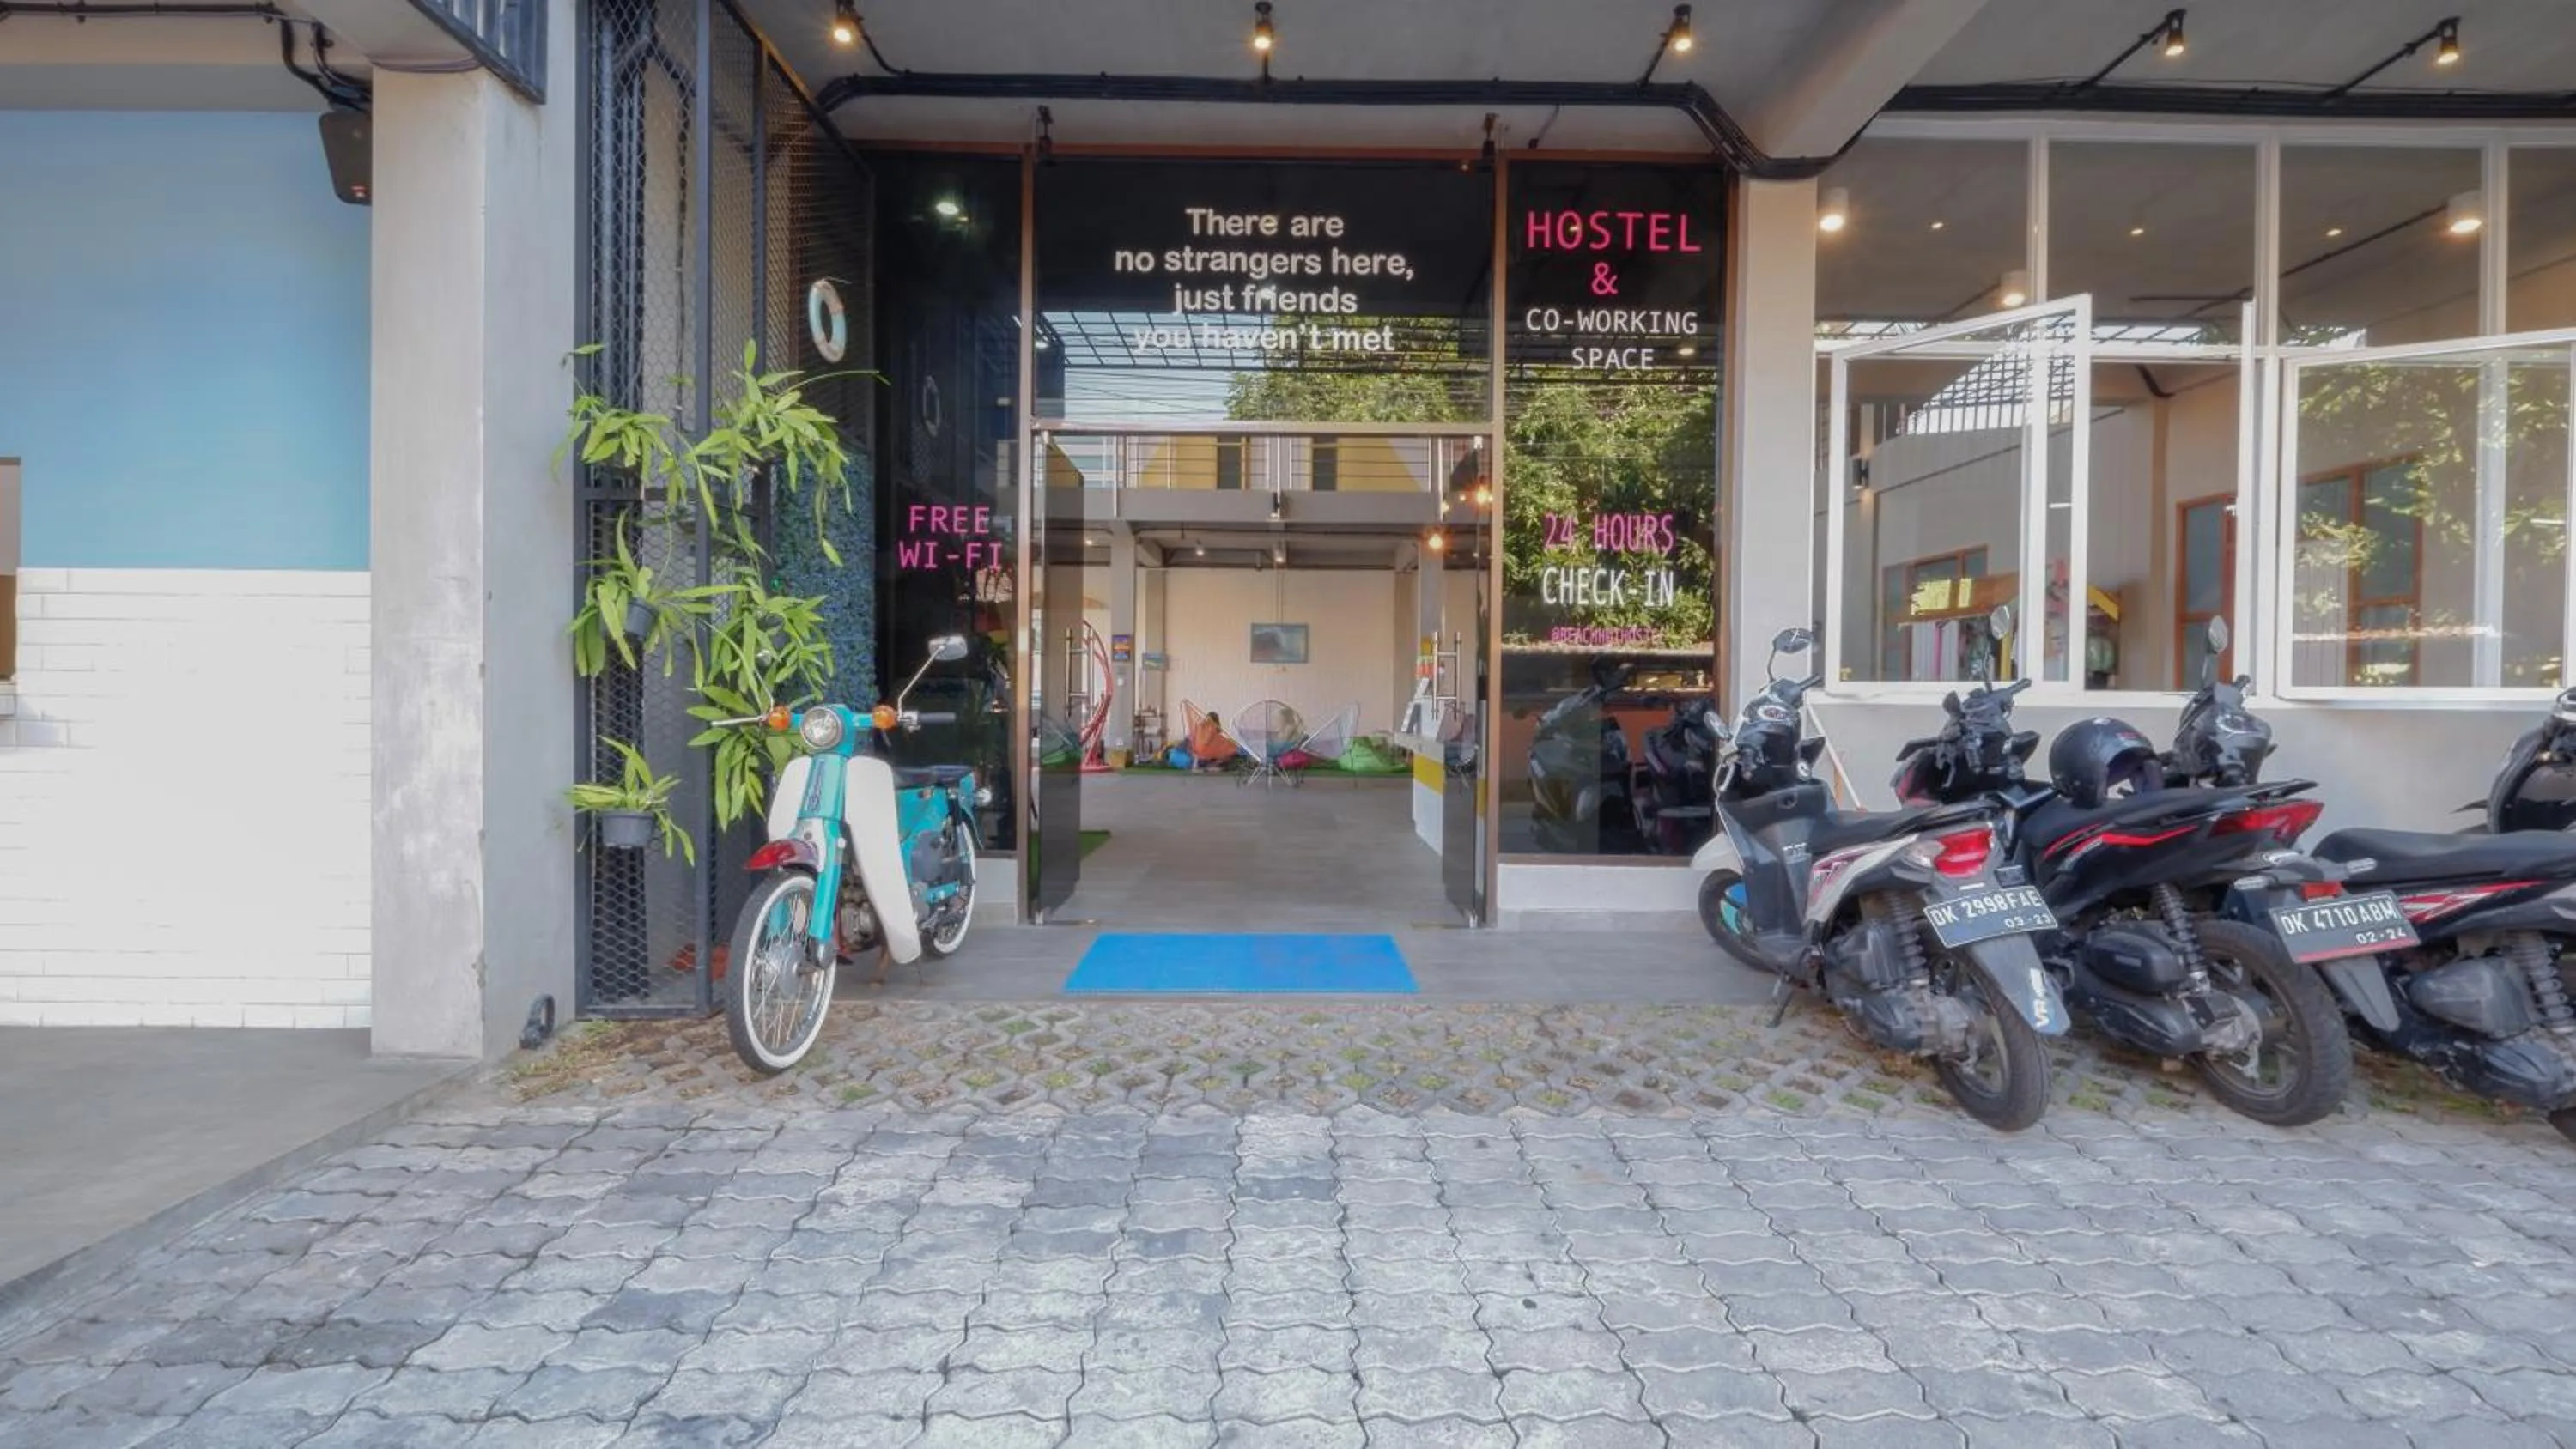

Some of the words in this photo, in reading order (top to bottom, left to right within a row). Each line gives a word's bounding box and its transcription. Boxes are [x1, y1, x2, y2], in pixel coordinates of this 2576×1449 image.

[1185, 208, 1278, 236] There
[1291, 215, 1345, 237] are
[1527, 210, 1703, 252] HOSTEL
[1115, 248, 1155, 272] no
[1163, 246, 1321, 280] strangers
[1331, 247, 1415, 281] here,
[1591, 262, 1619, 295] &
[1174, 283, 1235, 315] just
[1242, 285, 1358, 314] friends
[1525, 308, 1699, 335] CO-WORKING
[1133, 326, 1192, 353] you
[1202, 324, 1322, 352] haven't
[1333, 325, 1395, 352] met
[1571, 347, 1655, 371] SPACE
[909, 505, 990, 533] FREE
[1545, 512, 1576, 550] 24
[1593, 513, 1674, 555] HOURS
[898, 540, 1003, 569] WI-FI
[1929, 906, 1959, 926] DK
[2281, 912, 2309, 934] DK
